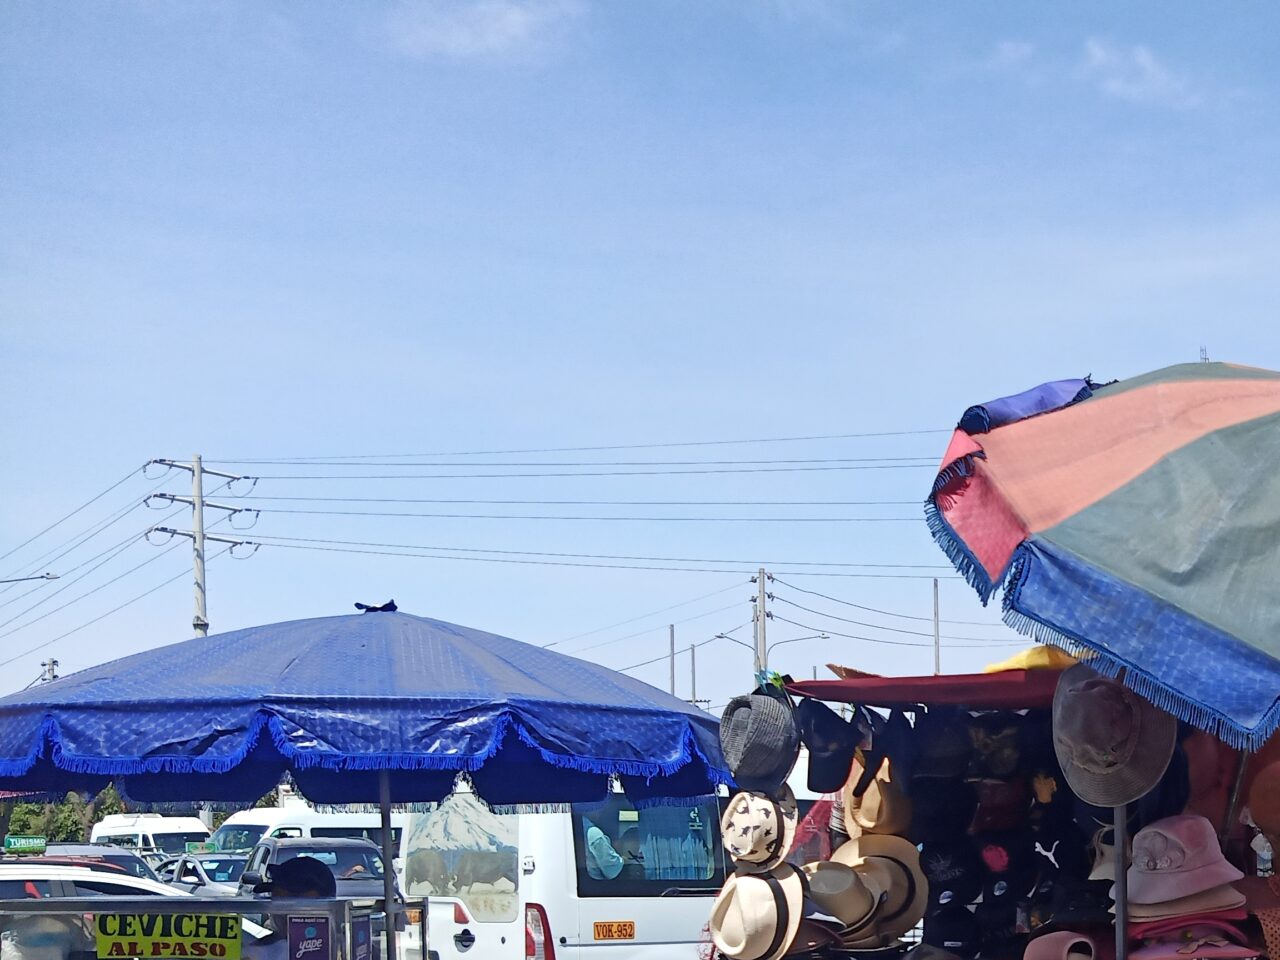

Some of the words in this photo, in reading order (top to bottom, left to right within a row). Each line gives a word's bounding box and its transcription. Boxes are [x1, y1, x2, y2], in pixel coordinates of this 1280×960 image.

[9, 838, 46, 847] TURISMO
[99, 913, 239, 940] CEVICHE
[107, 942, 144, 956] AL
[150, 942, 227, 957] PASO
[296, 938, 323, 959] yape
